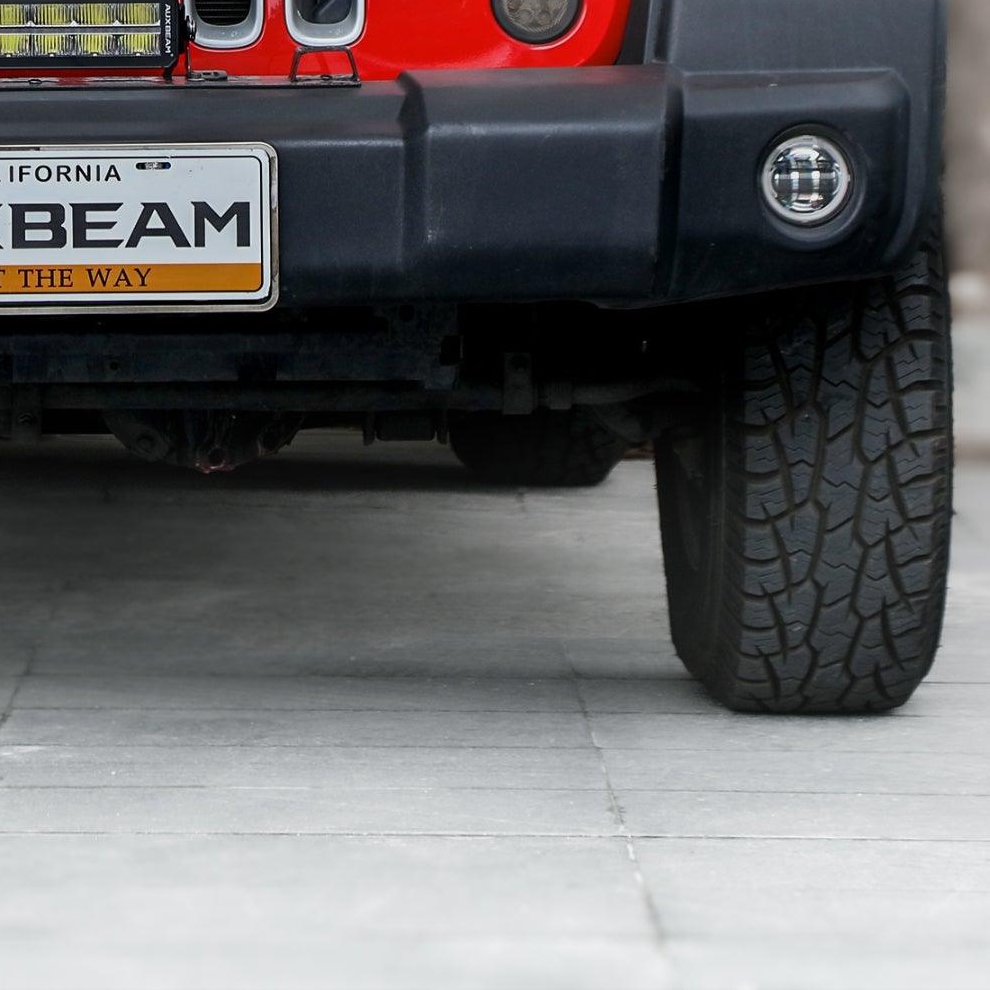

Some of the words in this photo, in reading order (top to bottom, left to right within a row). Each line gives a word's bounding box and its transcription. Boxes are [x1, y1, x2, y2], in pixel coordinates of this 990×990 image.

[164, 3, 172, 54] AUXBEAM
[18, 268, 74, 289] THE
[86, 267, 153, 288] WAY
